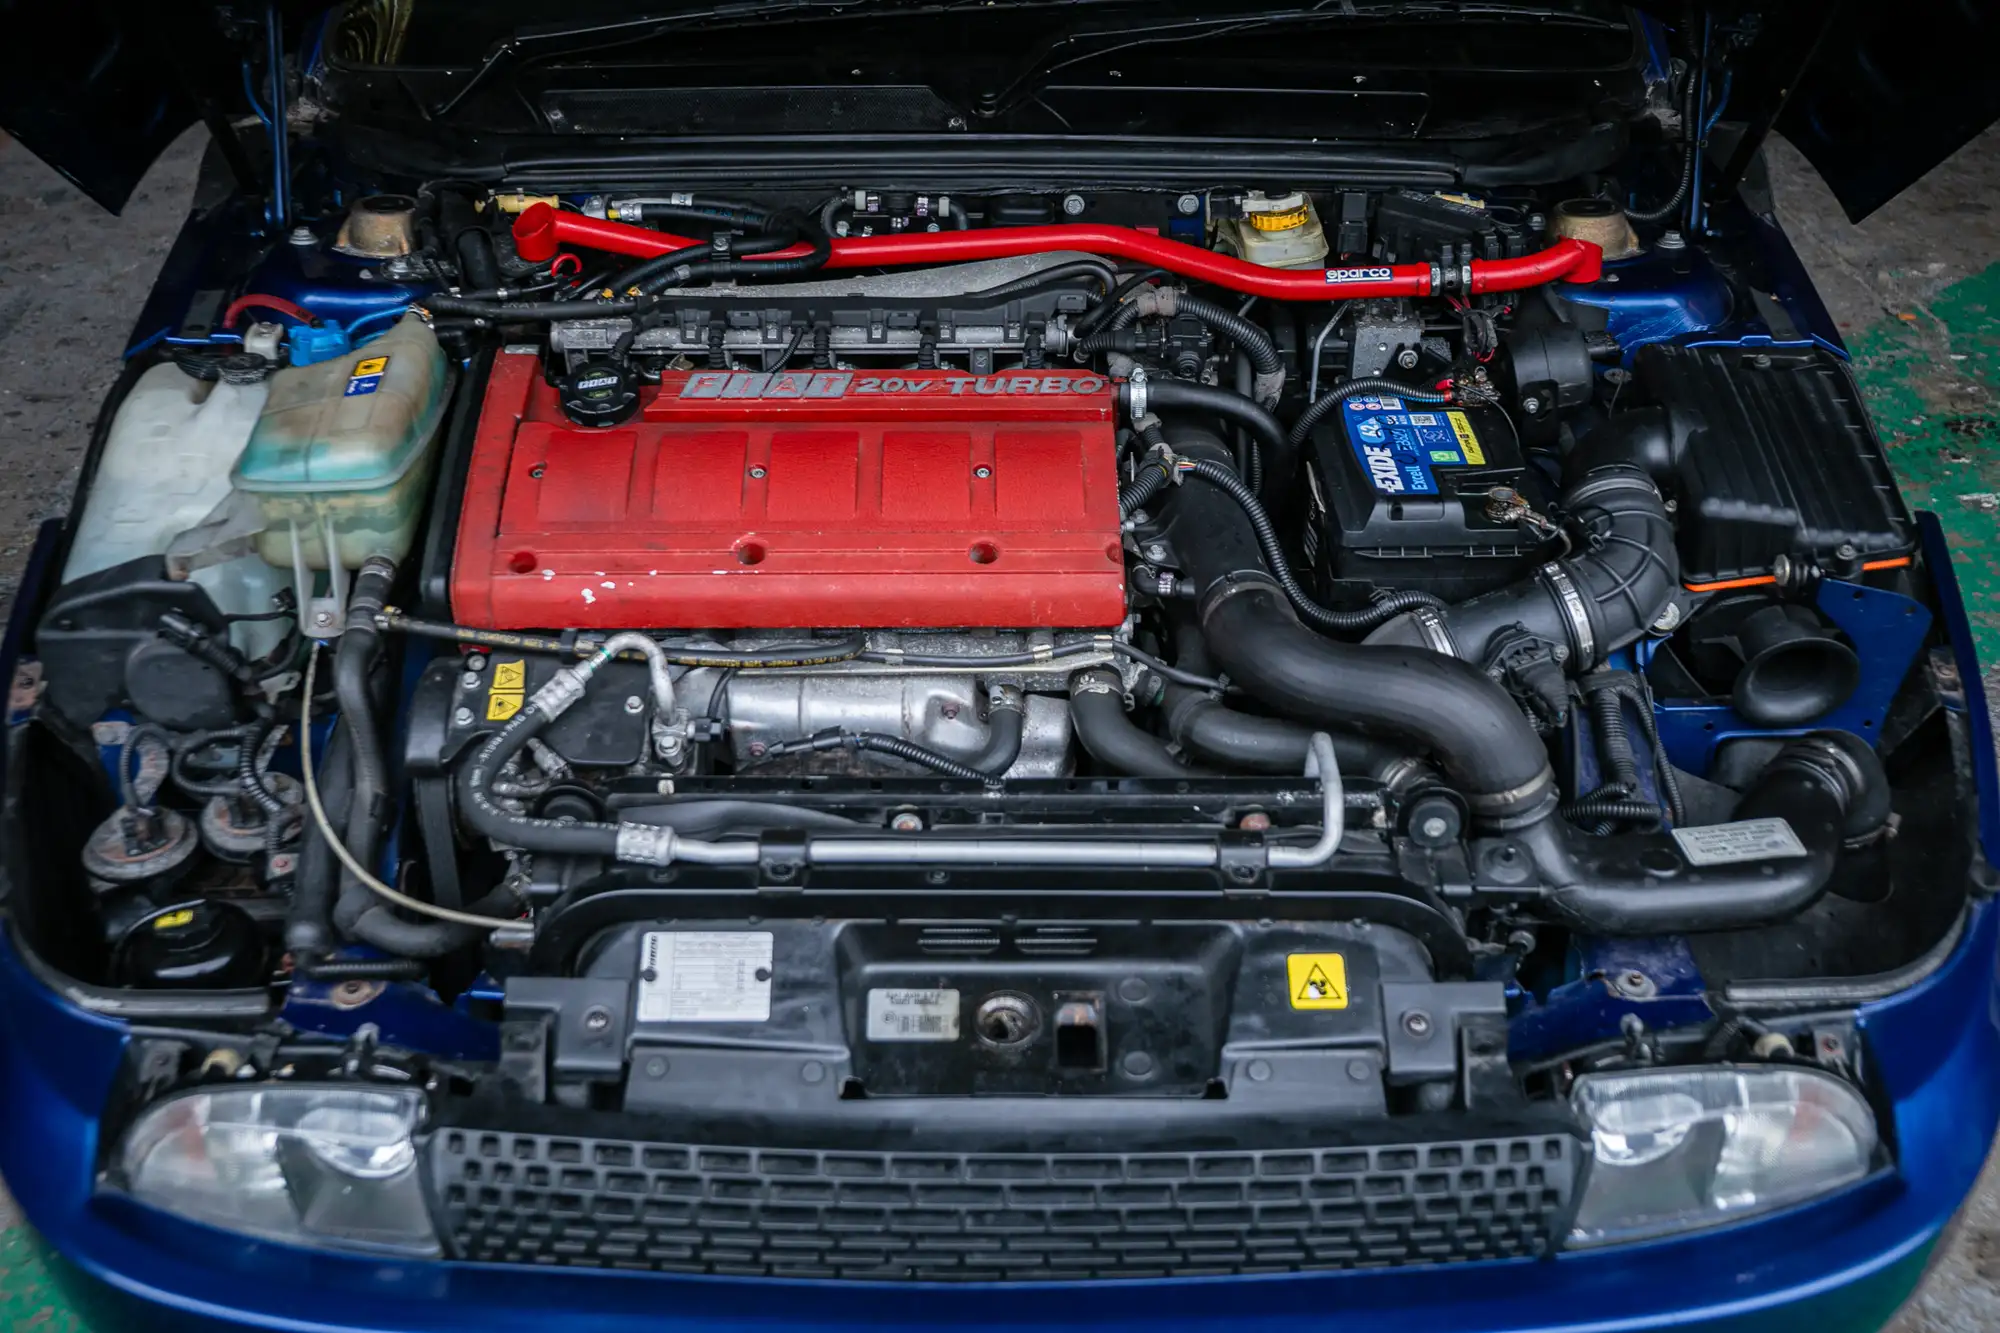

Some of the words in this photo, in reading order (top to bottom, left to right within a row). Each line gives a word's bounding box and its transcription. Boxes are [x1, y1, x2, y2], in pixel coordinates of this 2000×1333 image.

[1326, 268, 1391, 282] sparco
[680, 372, 853, 399] FIAT
[946, 377, 1105, 395] TURBO
[1363, 444, 1405, 493] EXIDE
[1405, 466, 1429, 491] Excell
